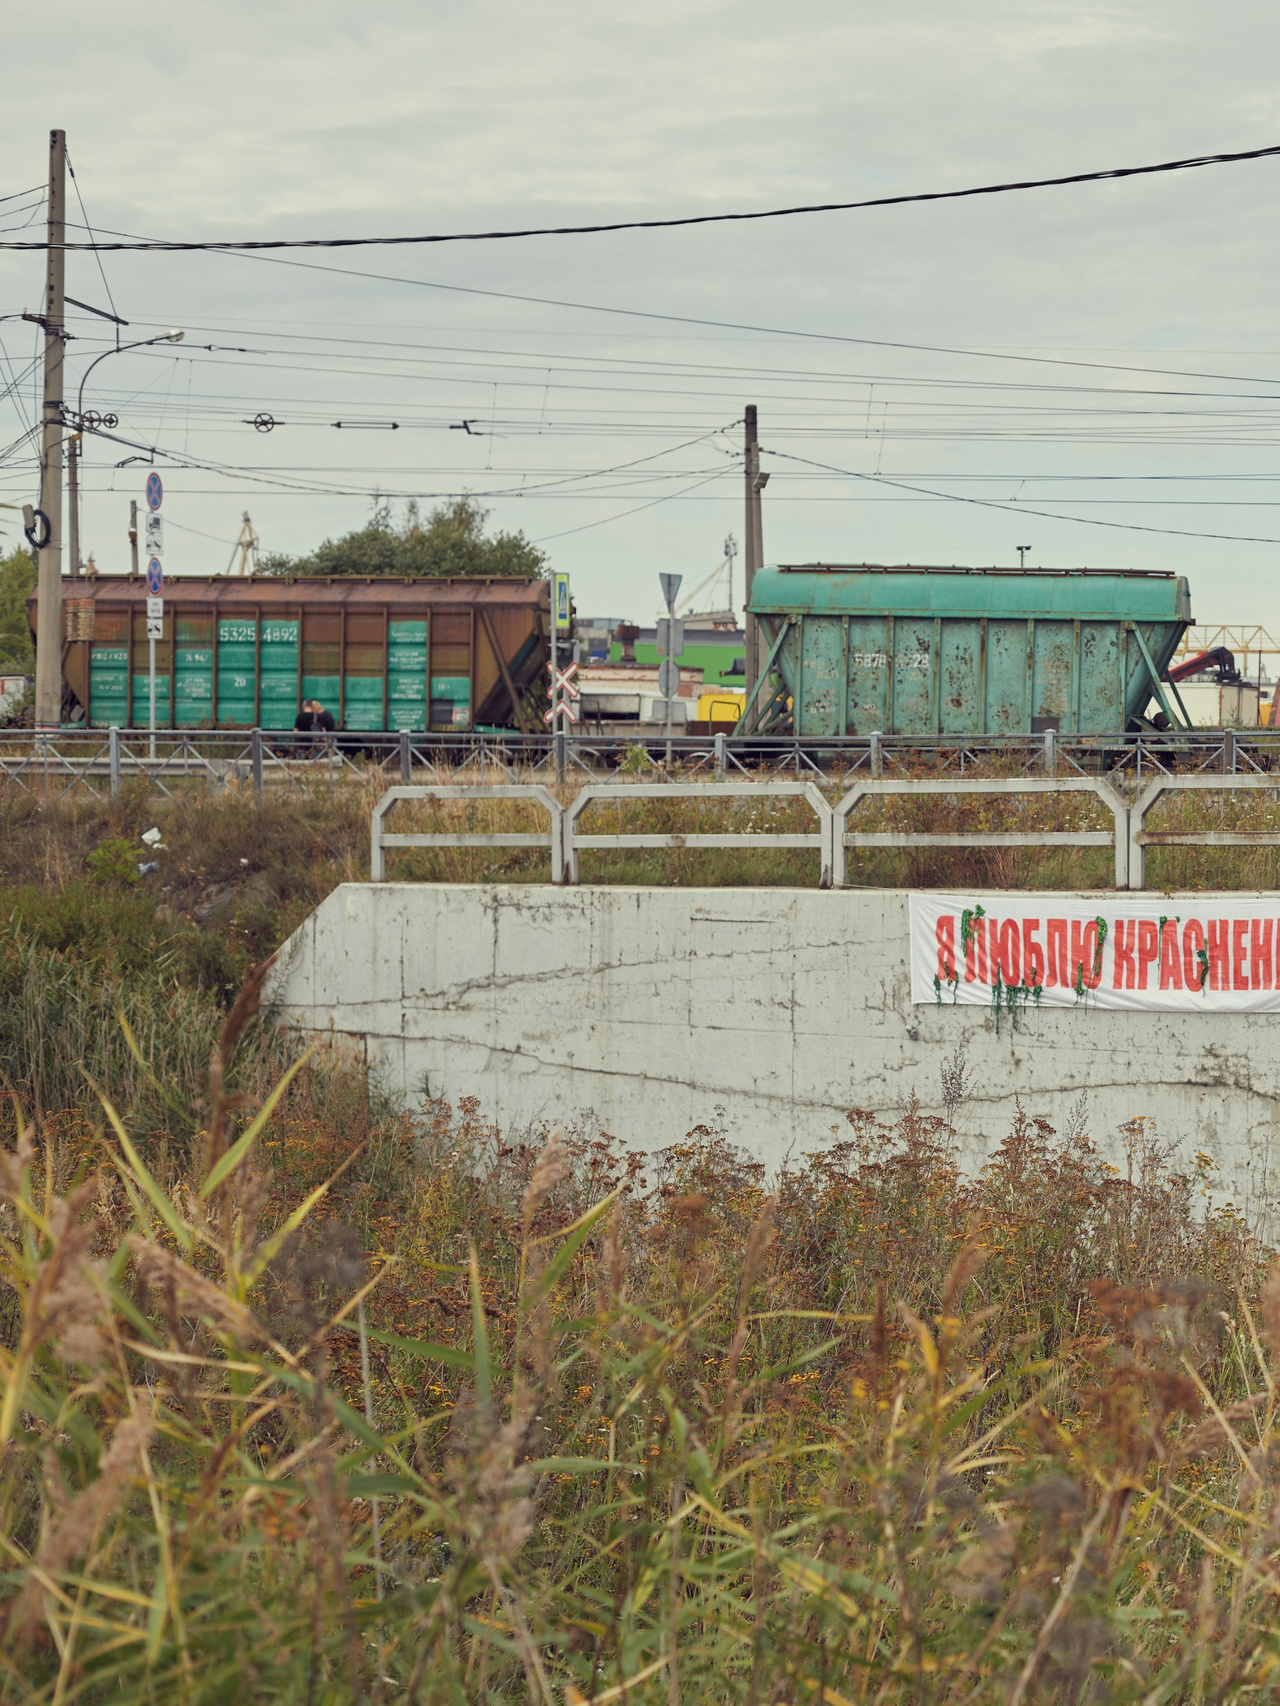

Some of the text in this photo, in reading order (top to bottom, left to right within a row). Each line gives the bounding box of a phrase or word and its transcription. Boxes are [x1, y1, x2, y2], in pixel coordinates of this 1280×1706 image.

[220, 627, 298, 643] 5325 4892
[234, 677, 246, 688] 20
[934, 915, 957, 982] Я
[964, 917, 1104, 989] ЛЮБЛЮ
